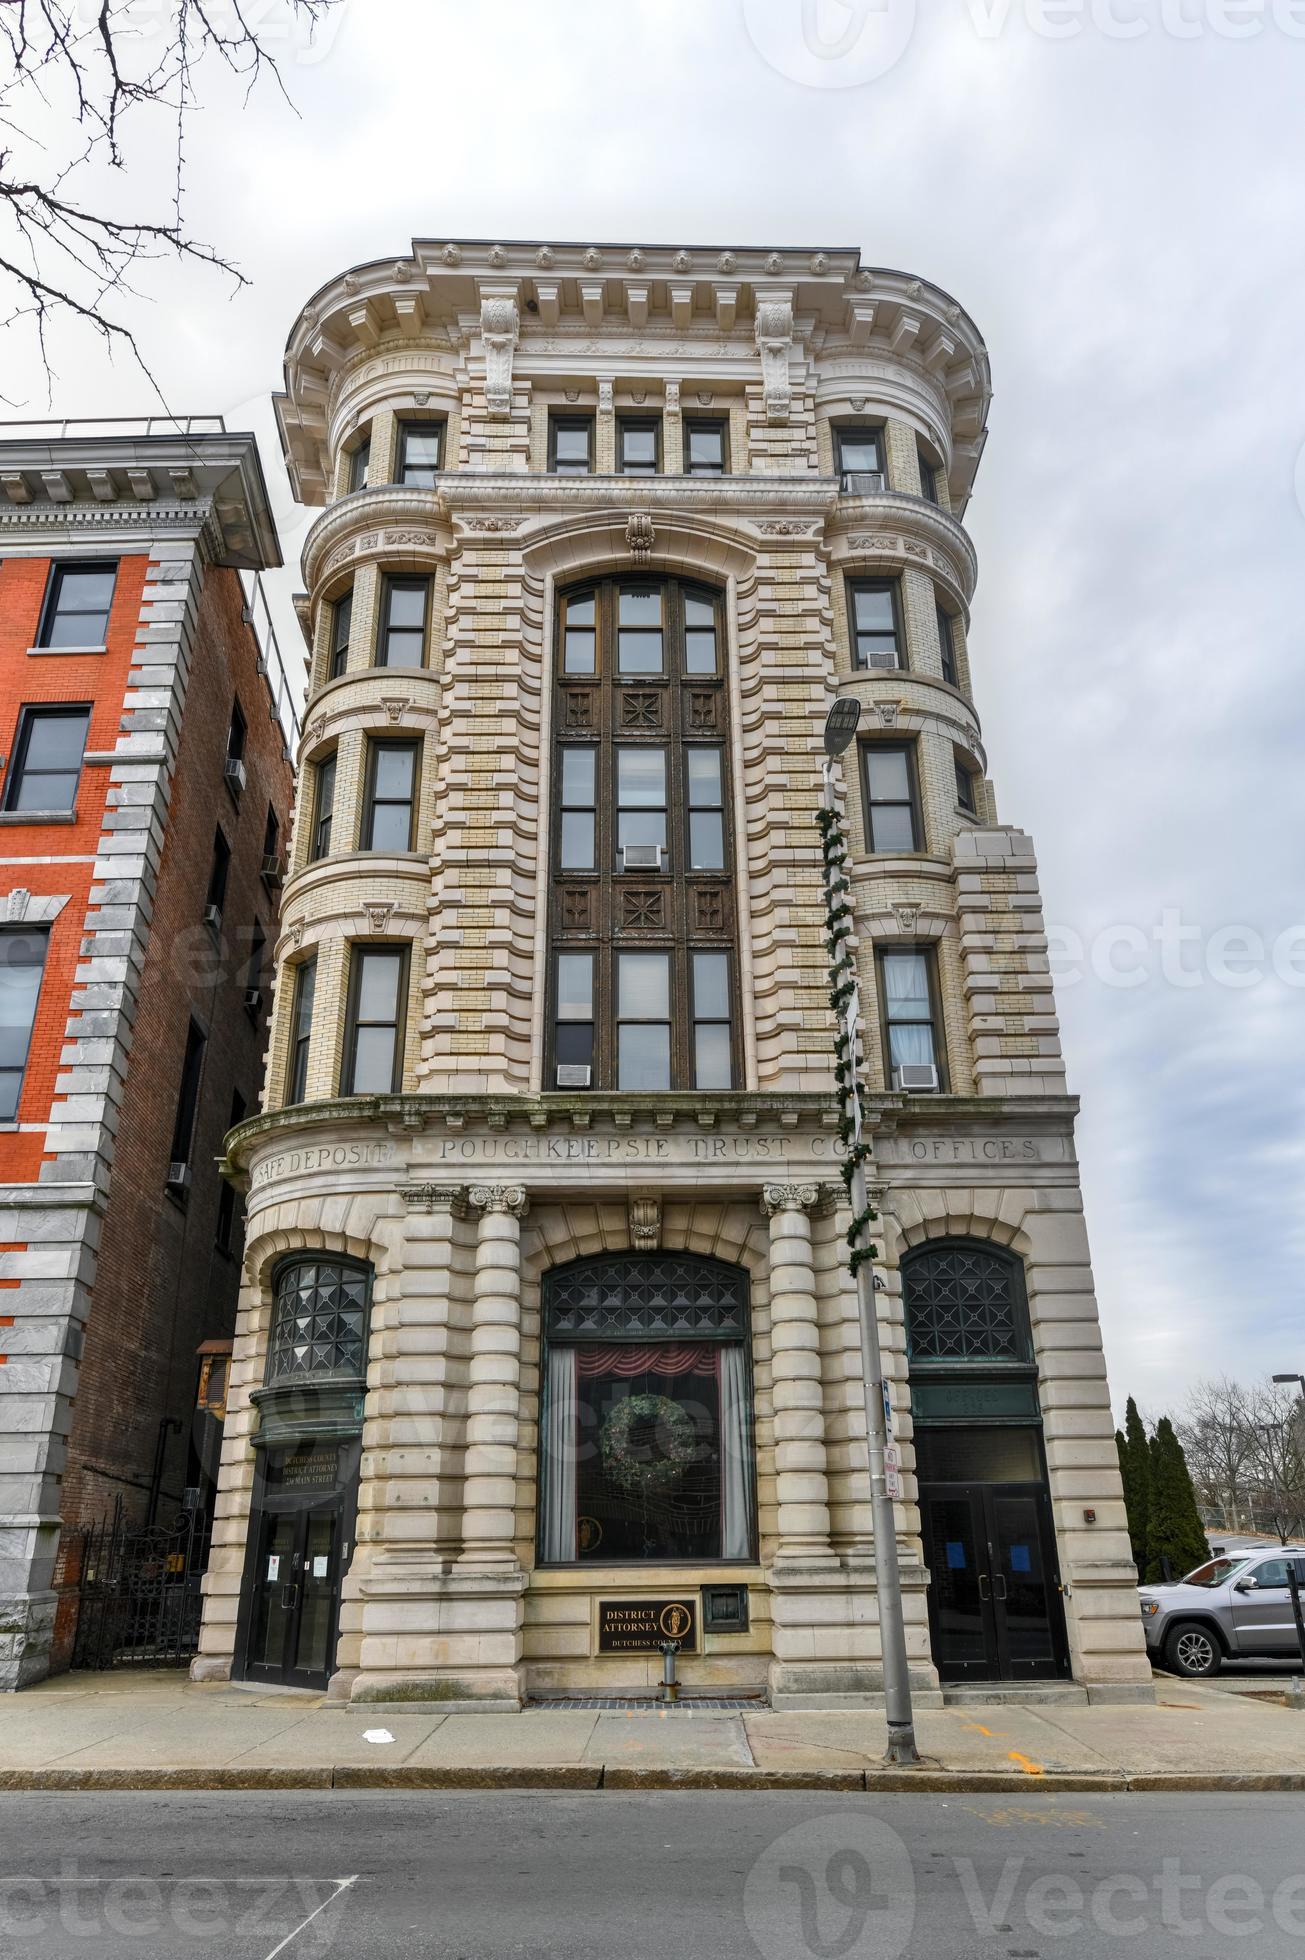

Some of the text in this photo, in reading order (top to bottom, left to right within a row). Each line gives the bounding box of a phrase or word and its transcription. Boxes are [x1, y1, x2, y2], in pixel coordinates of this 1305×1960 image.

[439, 1138, 670, 1160] POUGHKEEPSIE
[687, 1137, 791, 1158] TRUST
[911, 1139, 1036, 1161] OFFICES
[258, 1144, 388, 1184] SAFE DEPOSIT
[310, 1464, 338, 1473] ATTORNEY
[295, 1476, 310, 1485] MAIN
[312, 1474, 333, 1483] STREET
[606, 1610, 656, 1620] DISTRICT
[603, 1622, 659, 1632] ATTORNEY
